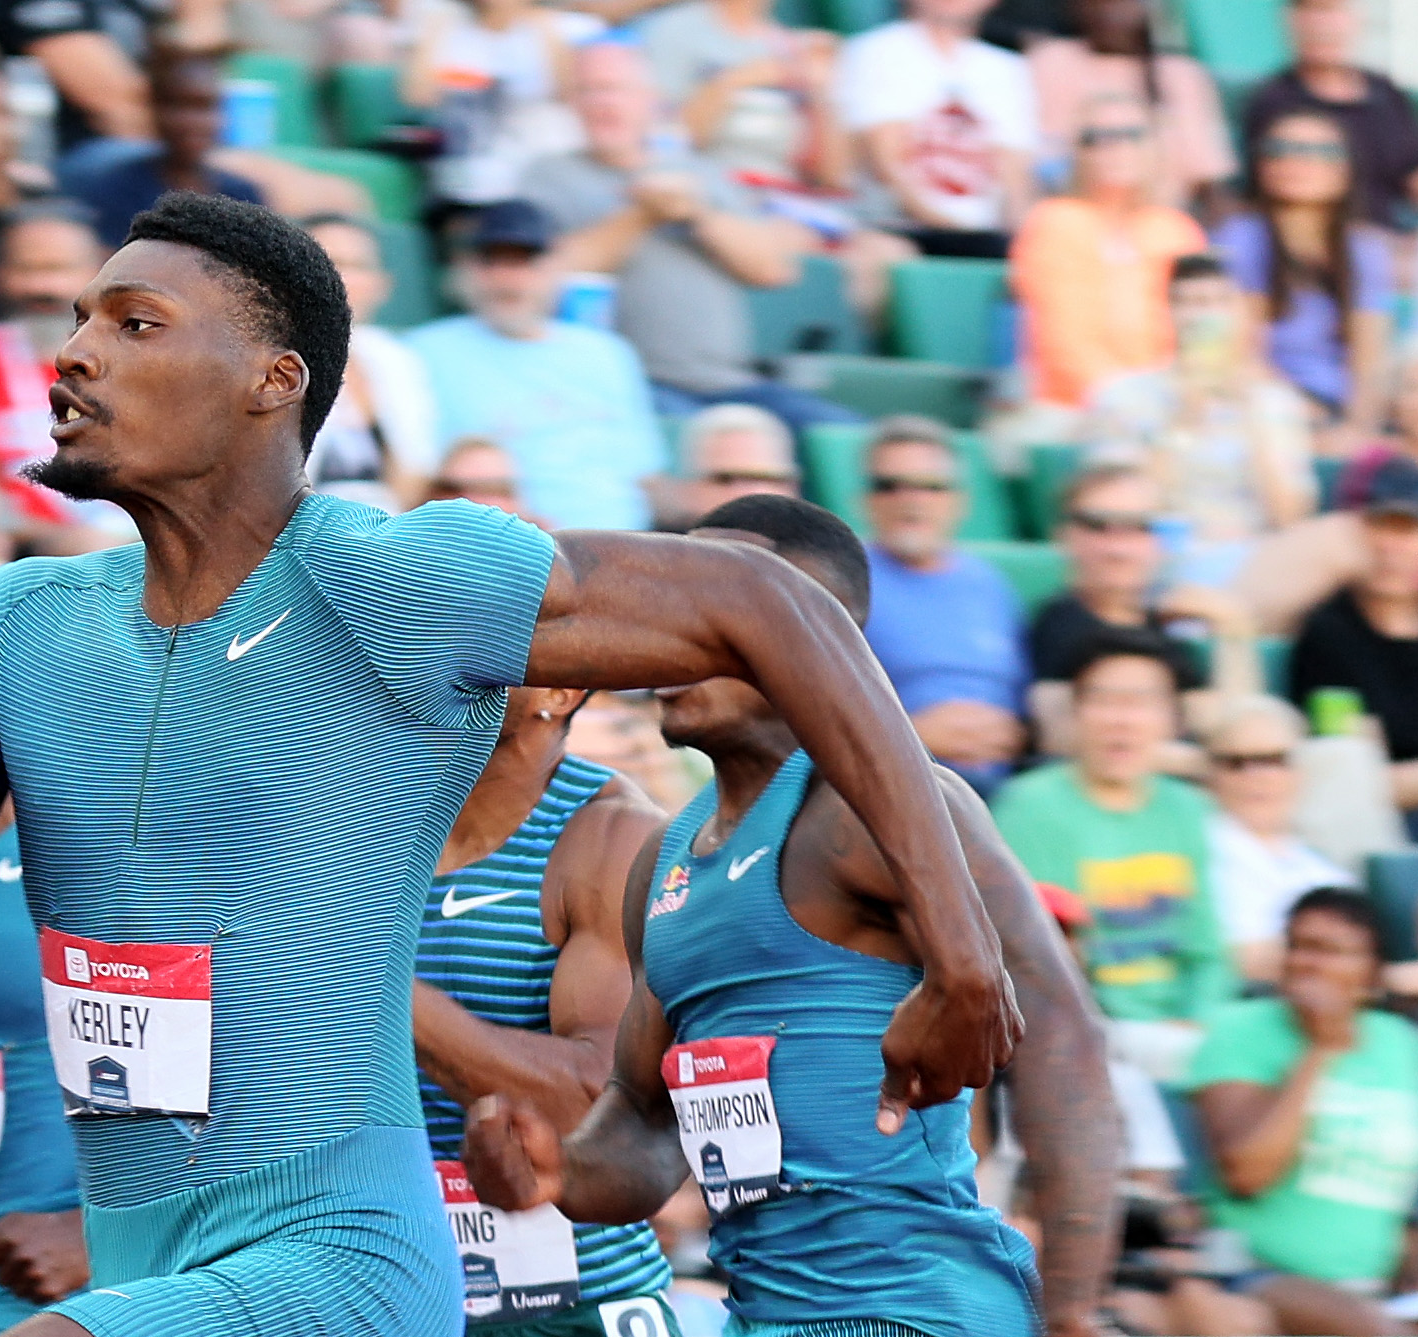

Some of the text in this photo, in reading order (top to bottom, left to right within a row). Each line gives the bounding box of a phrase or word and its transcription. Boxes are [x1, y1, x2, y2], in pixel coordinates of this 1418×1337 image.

[90, 961, 150, 980] TOYOTA
[69, 998, 150, 1049] KERLEY
[448, 1211, 496, 1244] ING
